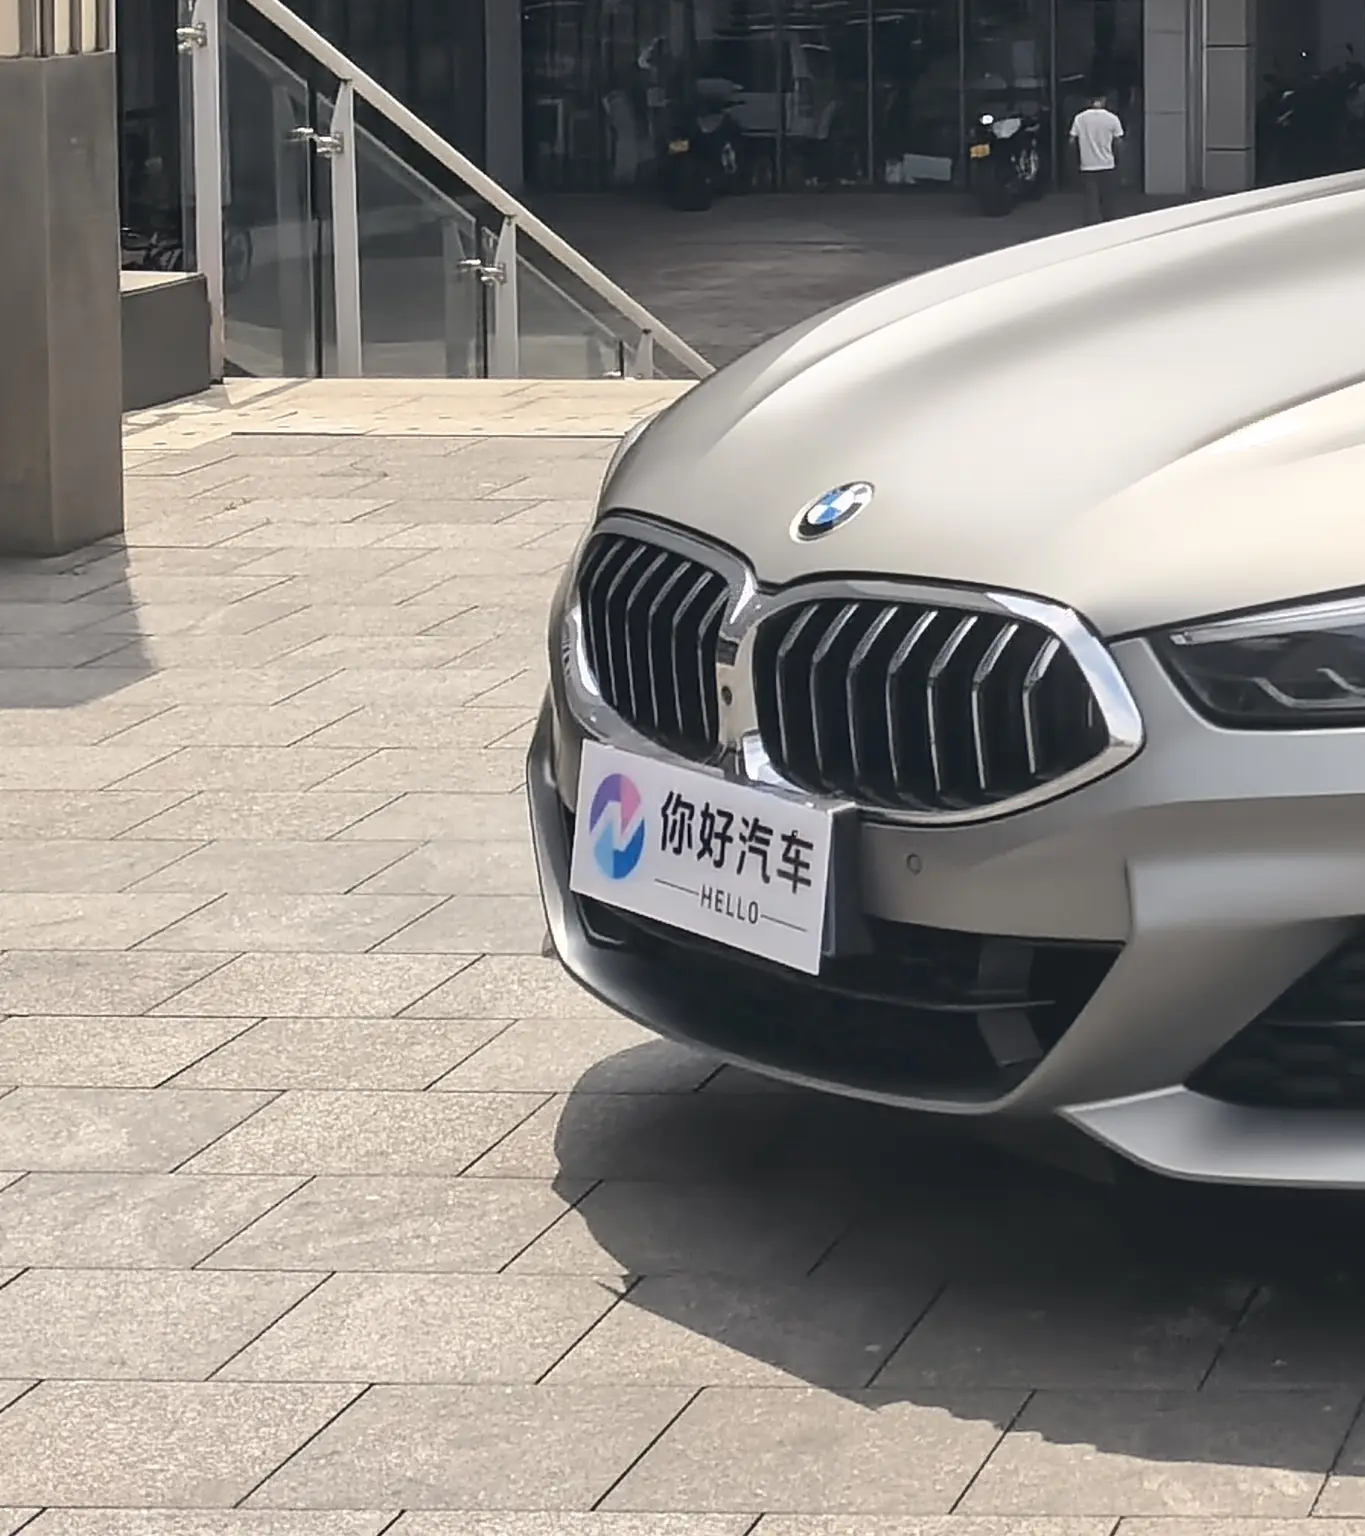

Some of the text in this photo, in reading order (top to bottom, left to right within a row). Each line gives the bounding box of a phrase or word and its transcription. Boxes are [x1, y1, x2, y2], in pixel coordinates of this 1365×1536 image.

[661, 791, 814, 893] 你好汽车
[701, 884, 759, 924] HELLO
